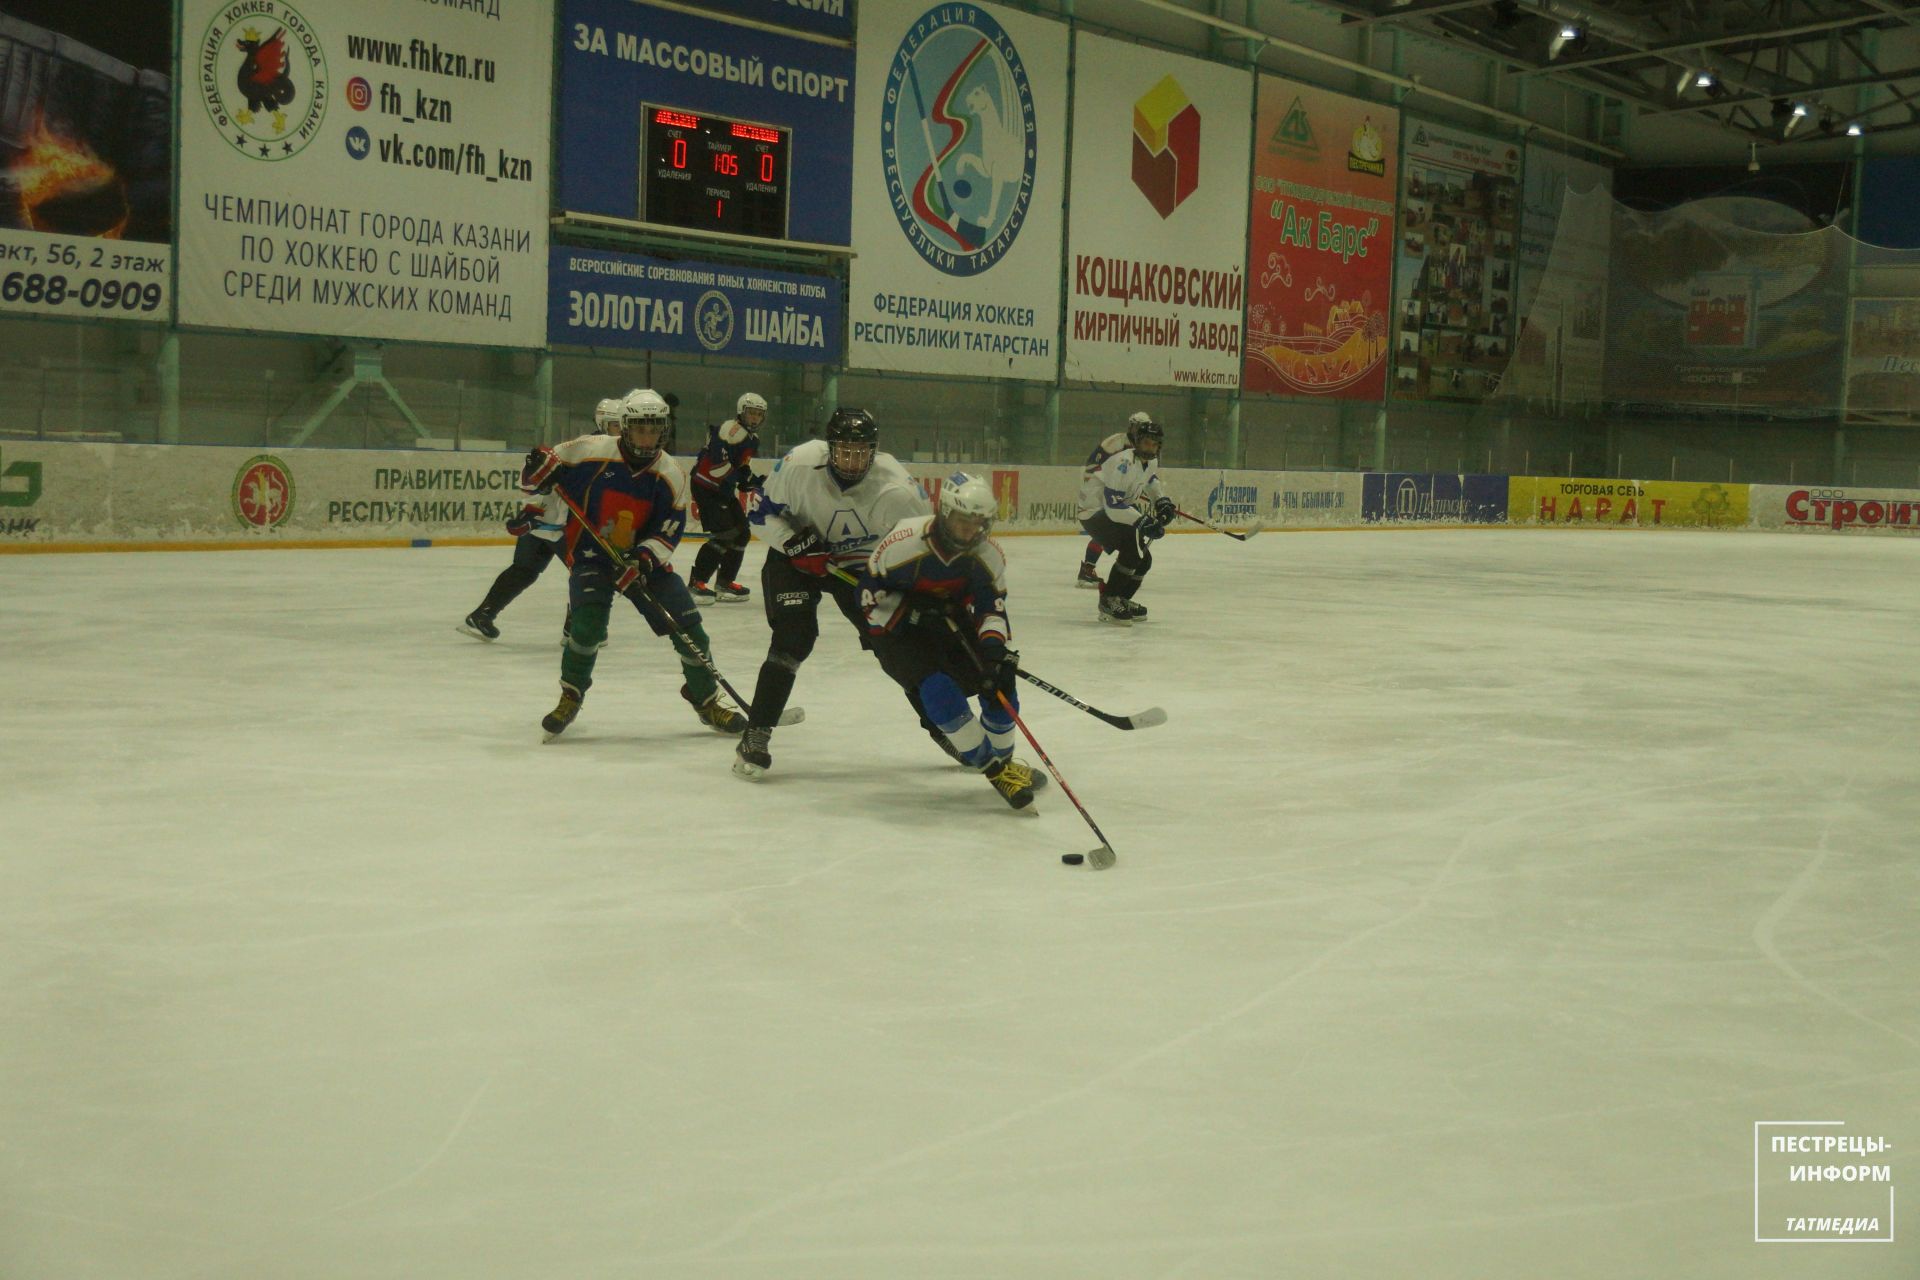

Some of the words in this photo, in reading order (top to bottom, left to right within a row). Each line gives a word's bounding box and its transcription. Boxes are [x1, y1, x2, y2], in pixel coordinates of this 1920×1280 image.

[225, 1, 274, 25] ХОККЕЯ
[283, 10, 321, 67] ГОРОДА
[347, 35, 495, 83] www.fhkzn.ru
[204, 27, 227, 126] ФЕДЕРАЦИЯ
[573, 23, 609, 56] ЗА
[616, 32, 764, 87] МАССОВЫЙ
[771, 66, 849, 103] СПОРТ
[887, 8, 976, 104] ФЕДЕРАЦИЯ
[995, 31, 1035, 133] ХОККЕЯ
[299, 80, 325, 140] КАЗАНИ
[380, 83, 452, 123] fh_kzn
[379, 133, 532, 182] vk.com/fh_kzn
[674, 139, 687, 168] 0
[715, 153, 738, 175] 1:05
[761, 154, 773, 182] 0
[205, 193, 350, 235] ЧЕМПИОНАТ
[361, 212, 443, 247] ГОРОДА
[453, 222, 530, 253] КАЗАНИ
[885, 148, 956, 270] РЕСПУБЛИКИ
[970, 173, 1031, 270] ТАТАРСТАН
[47, 243, 81, 270] 56,
[90, 248, 104, 268] 2
[111, 254, 165, 273] этаж
[241, 235, 274, 263] ПО
[285, 239, 377, 273] ХОККЕЮ
[389, 250, 400, 275] С
[411, 251, 500, 284] ШАЙБОЙ
[570, 257, 645, 279] ВСЕРОССИЙСКИЕ
[648, 265, 715, 286] СОРЕВНОВАНИЯ
[717, 274, 744, 290] ЮНЫХ
[747, 277, 797, 296] ХОККЕИСТОВ
[800, 284, 826, 299] КЛУБА
[2, 271, 162, 312] 688-0909
[224, 270, 301, 304] СРЕДИ
[313, 278, 418, 311] МУЖСКИХ
[428, 289, 512, 322] КОМАНД
[1076, 254, 1242, 311] КОЩАКОВСКИЙ
[568, 290, 684, 335] ЗОЛОТАЯ
[745, 305, 825, 348] ШАЙБА
[874, 292, 971, 323] ФЕДЕРАЦИЯ
[975, 303, 1034, 327] ХОККЕЯ
[854, 322, 960, 350] РЕСПУБЛИКИ
[964, 331, 1049, 357] ТАТАРСТАН
[1074, 310, 1180, 348] КИРПИЧНЫЙ
[1189, 320, 1239, 358] ЗАВОД
[1174, 368, 1238, 385] www.kkcm.ru
[375, 468, 521, 490] ПРАВИТЕЛЬСТВ
[1560, 483, 1613, 496] ТОРГОВАЯ
[1617, 485, 1645, 497] СЕТЬ
[1540, 496, 1667, 525] НАРАТ
